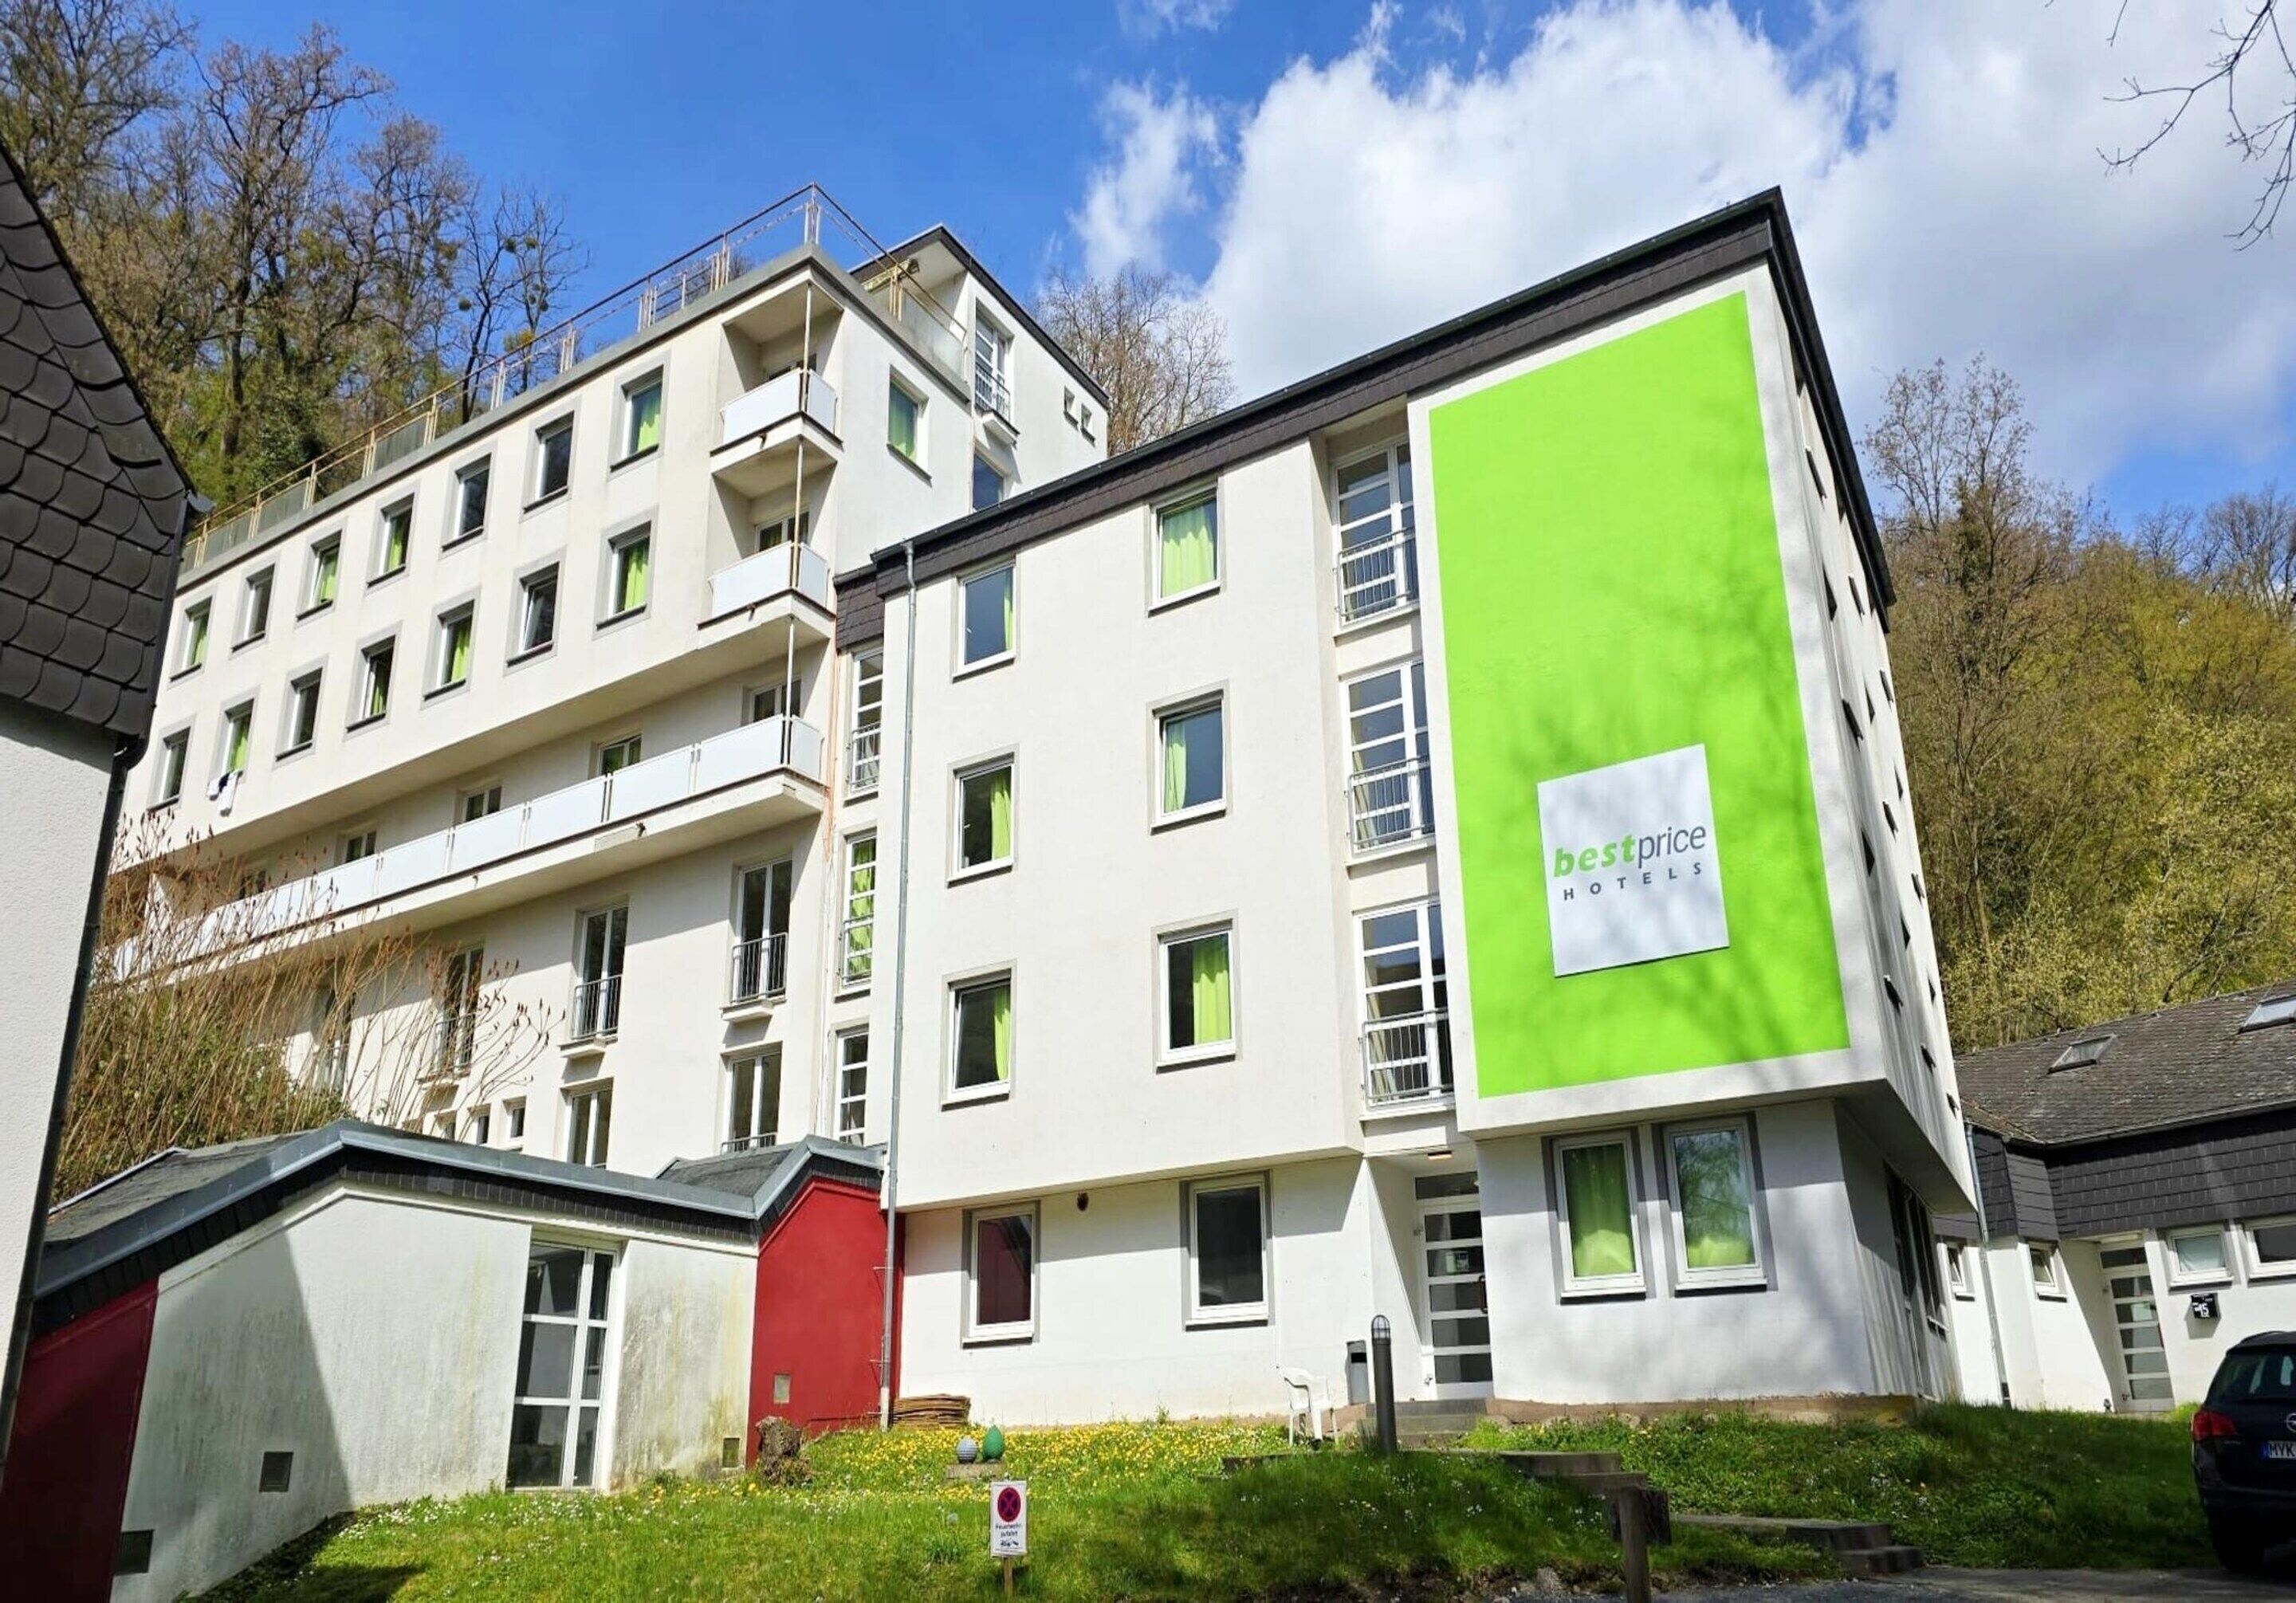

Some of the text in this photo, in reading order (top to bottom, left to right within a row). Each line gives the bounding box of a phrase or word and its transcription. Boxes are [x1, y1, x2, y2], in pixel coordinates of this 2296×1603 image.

[1555, 826, 1706, 878] bestprice
[1563, 862, 1701, 900] HOTELS
[2269, 1443, 2295, 1457] MYK
